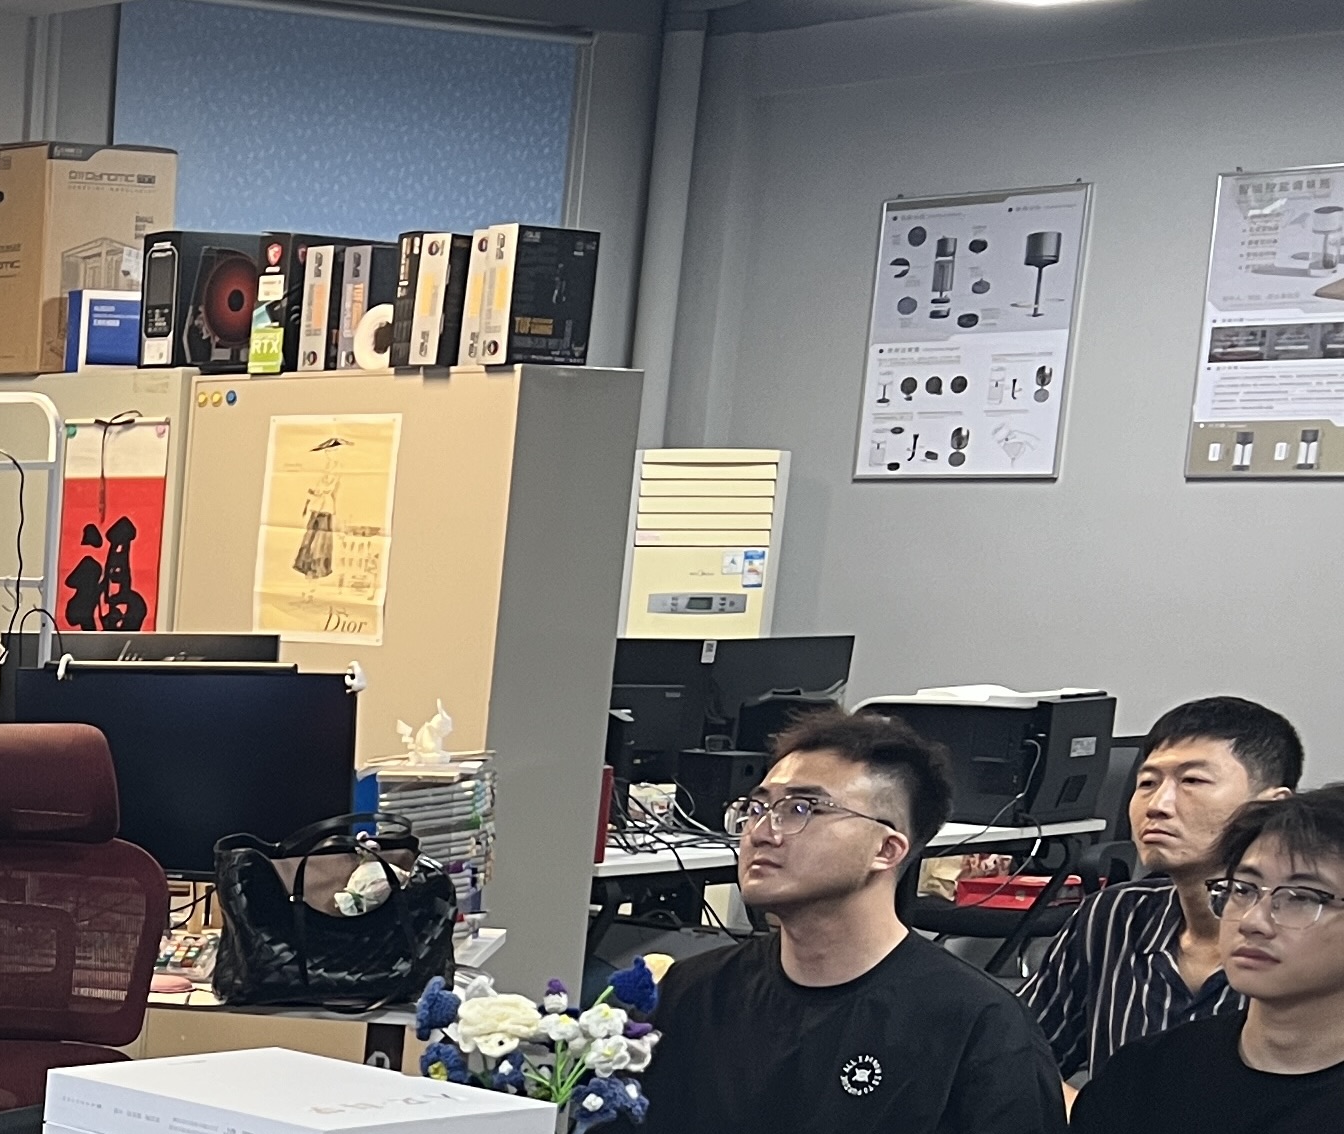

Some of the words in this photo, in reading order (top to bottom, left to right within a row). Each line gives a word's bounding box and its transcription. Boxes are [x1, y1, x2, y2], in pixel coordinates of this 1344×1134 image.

[251, 339, 279, 355] RTX
[65, 516, 147, 631] 福
[322, 611, 368, 634] Dior
